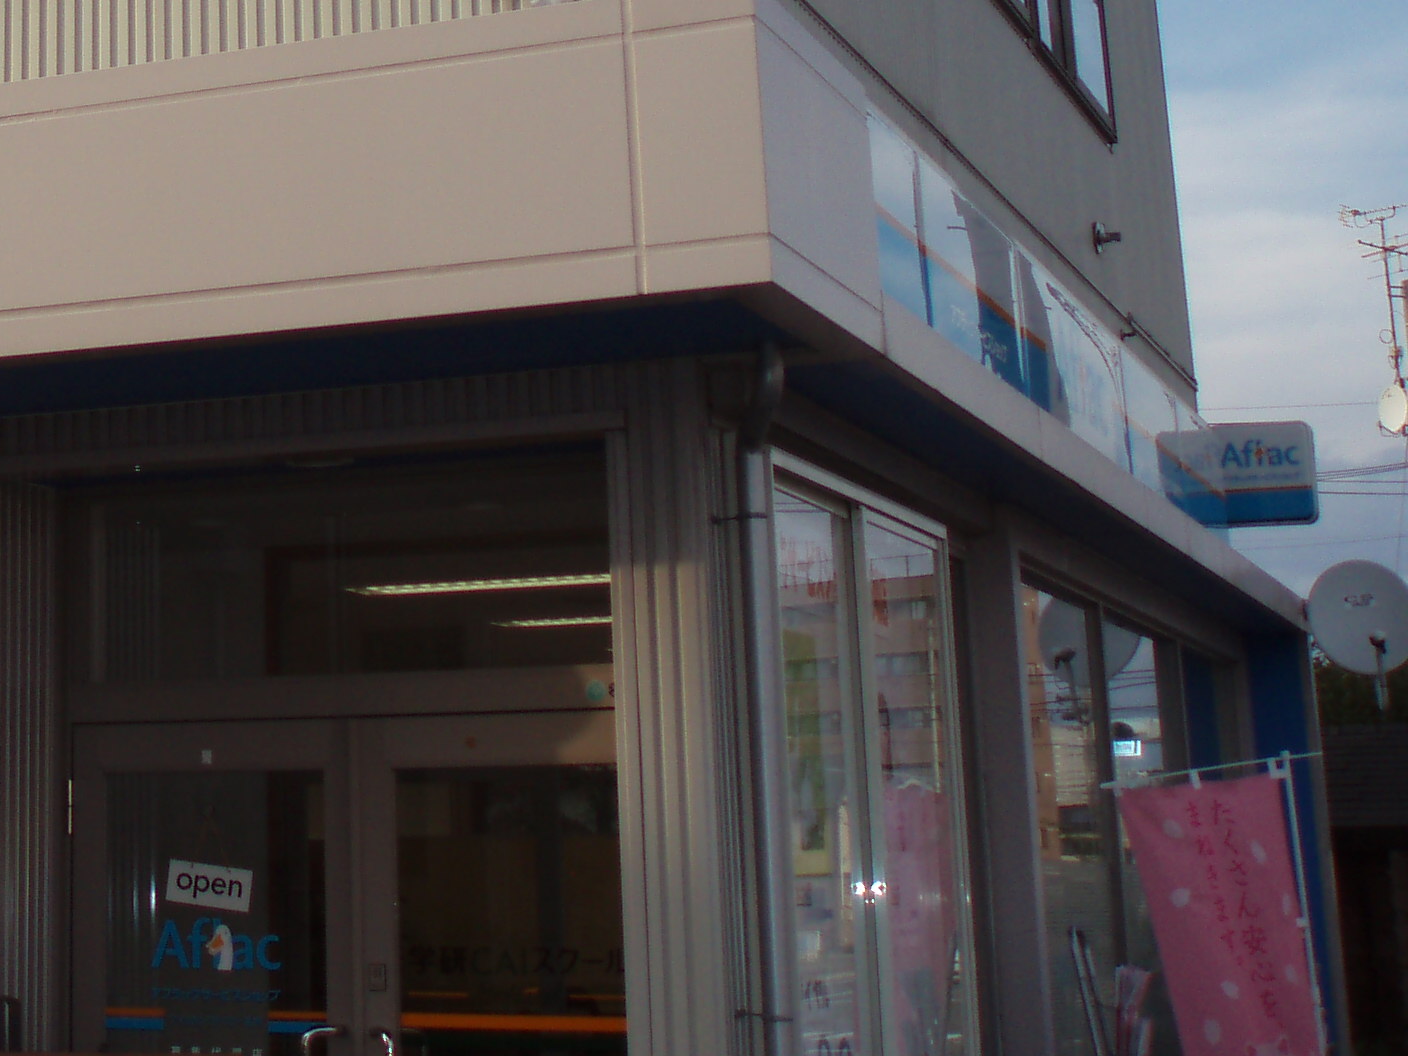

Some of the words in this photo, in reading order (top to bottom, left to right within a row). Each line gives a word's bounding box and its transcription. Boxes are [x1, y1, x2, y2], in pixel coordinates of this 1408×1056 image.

[1221, 439, 1300, 469] Aflac
[176, 871, 243, 898] open
[152, 916, 281, 971] Aflac
